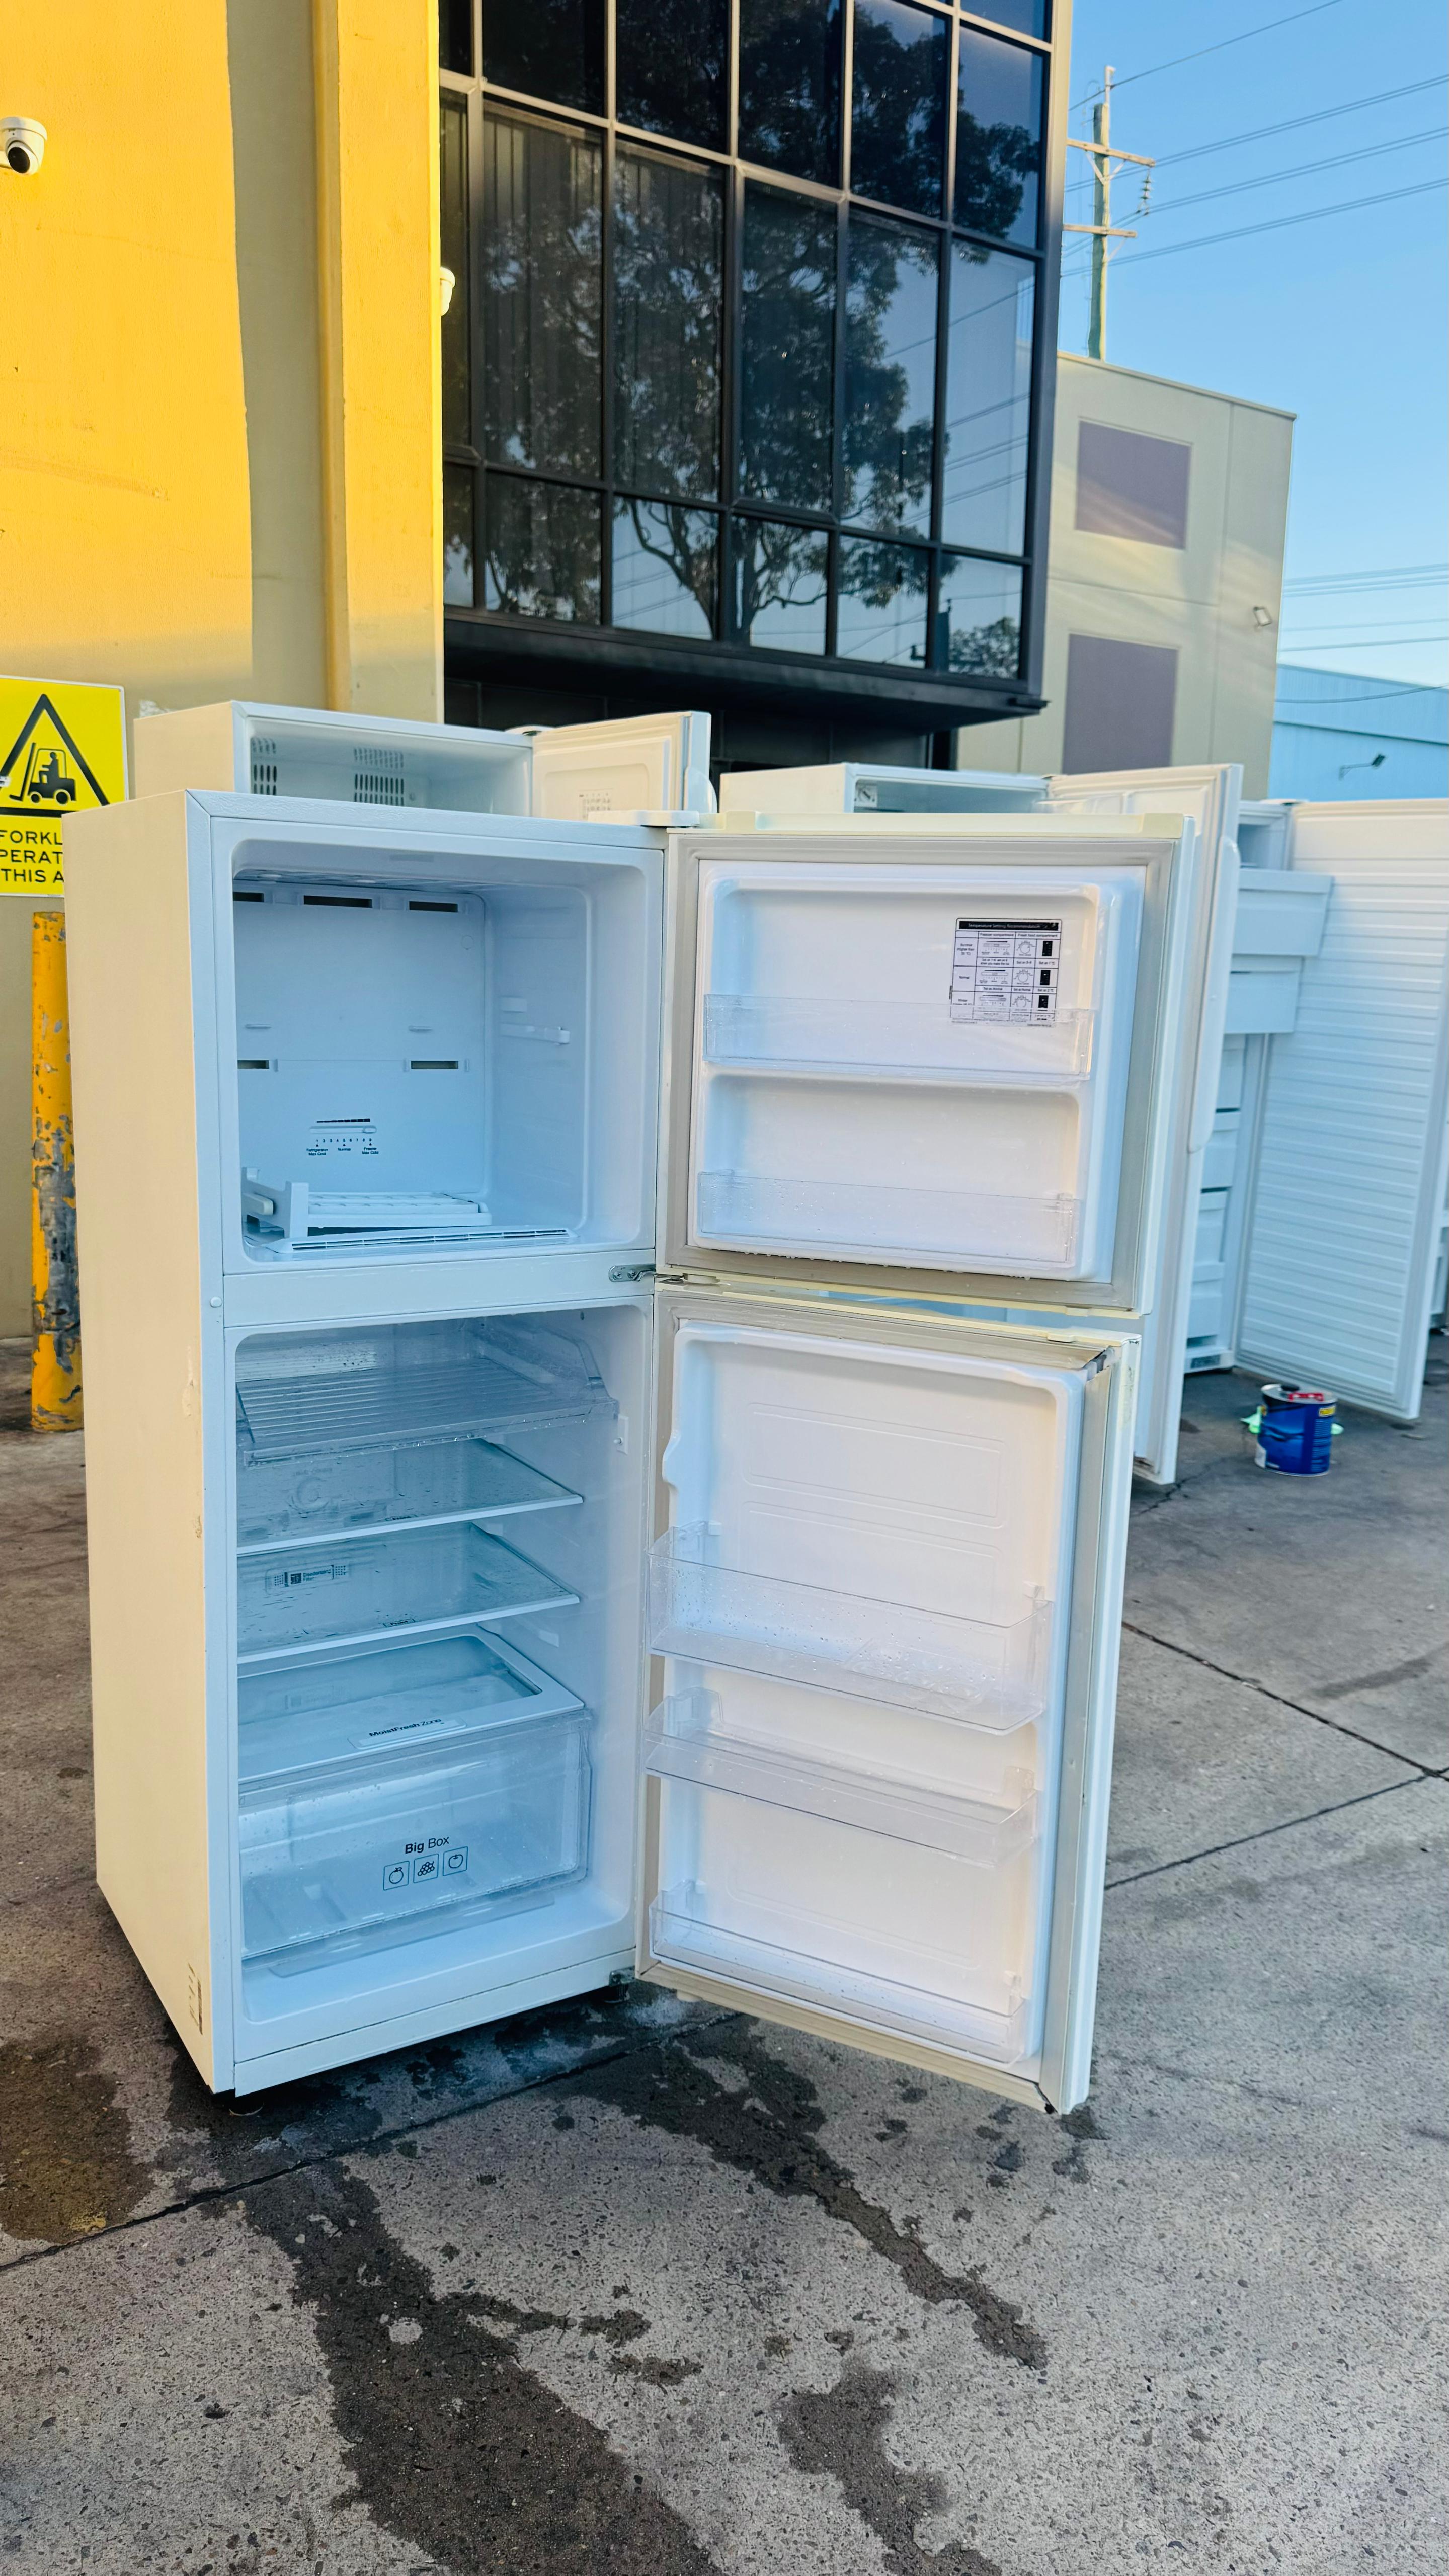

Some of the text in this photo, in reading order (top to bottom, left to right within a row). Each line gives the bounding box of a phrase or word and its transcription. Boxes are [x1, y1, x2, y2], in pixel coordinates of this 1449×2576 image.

[1, 868, 46, 883] THIS
[369, 1723, 420, 1737] MoistFresh
[405, 1836, 450, 1854] Big Box
